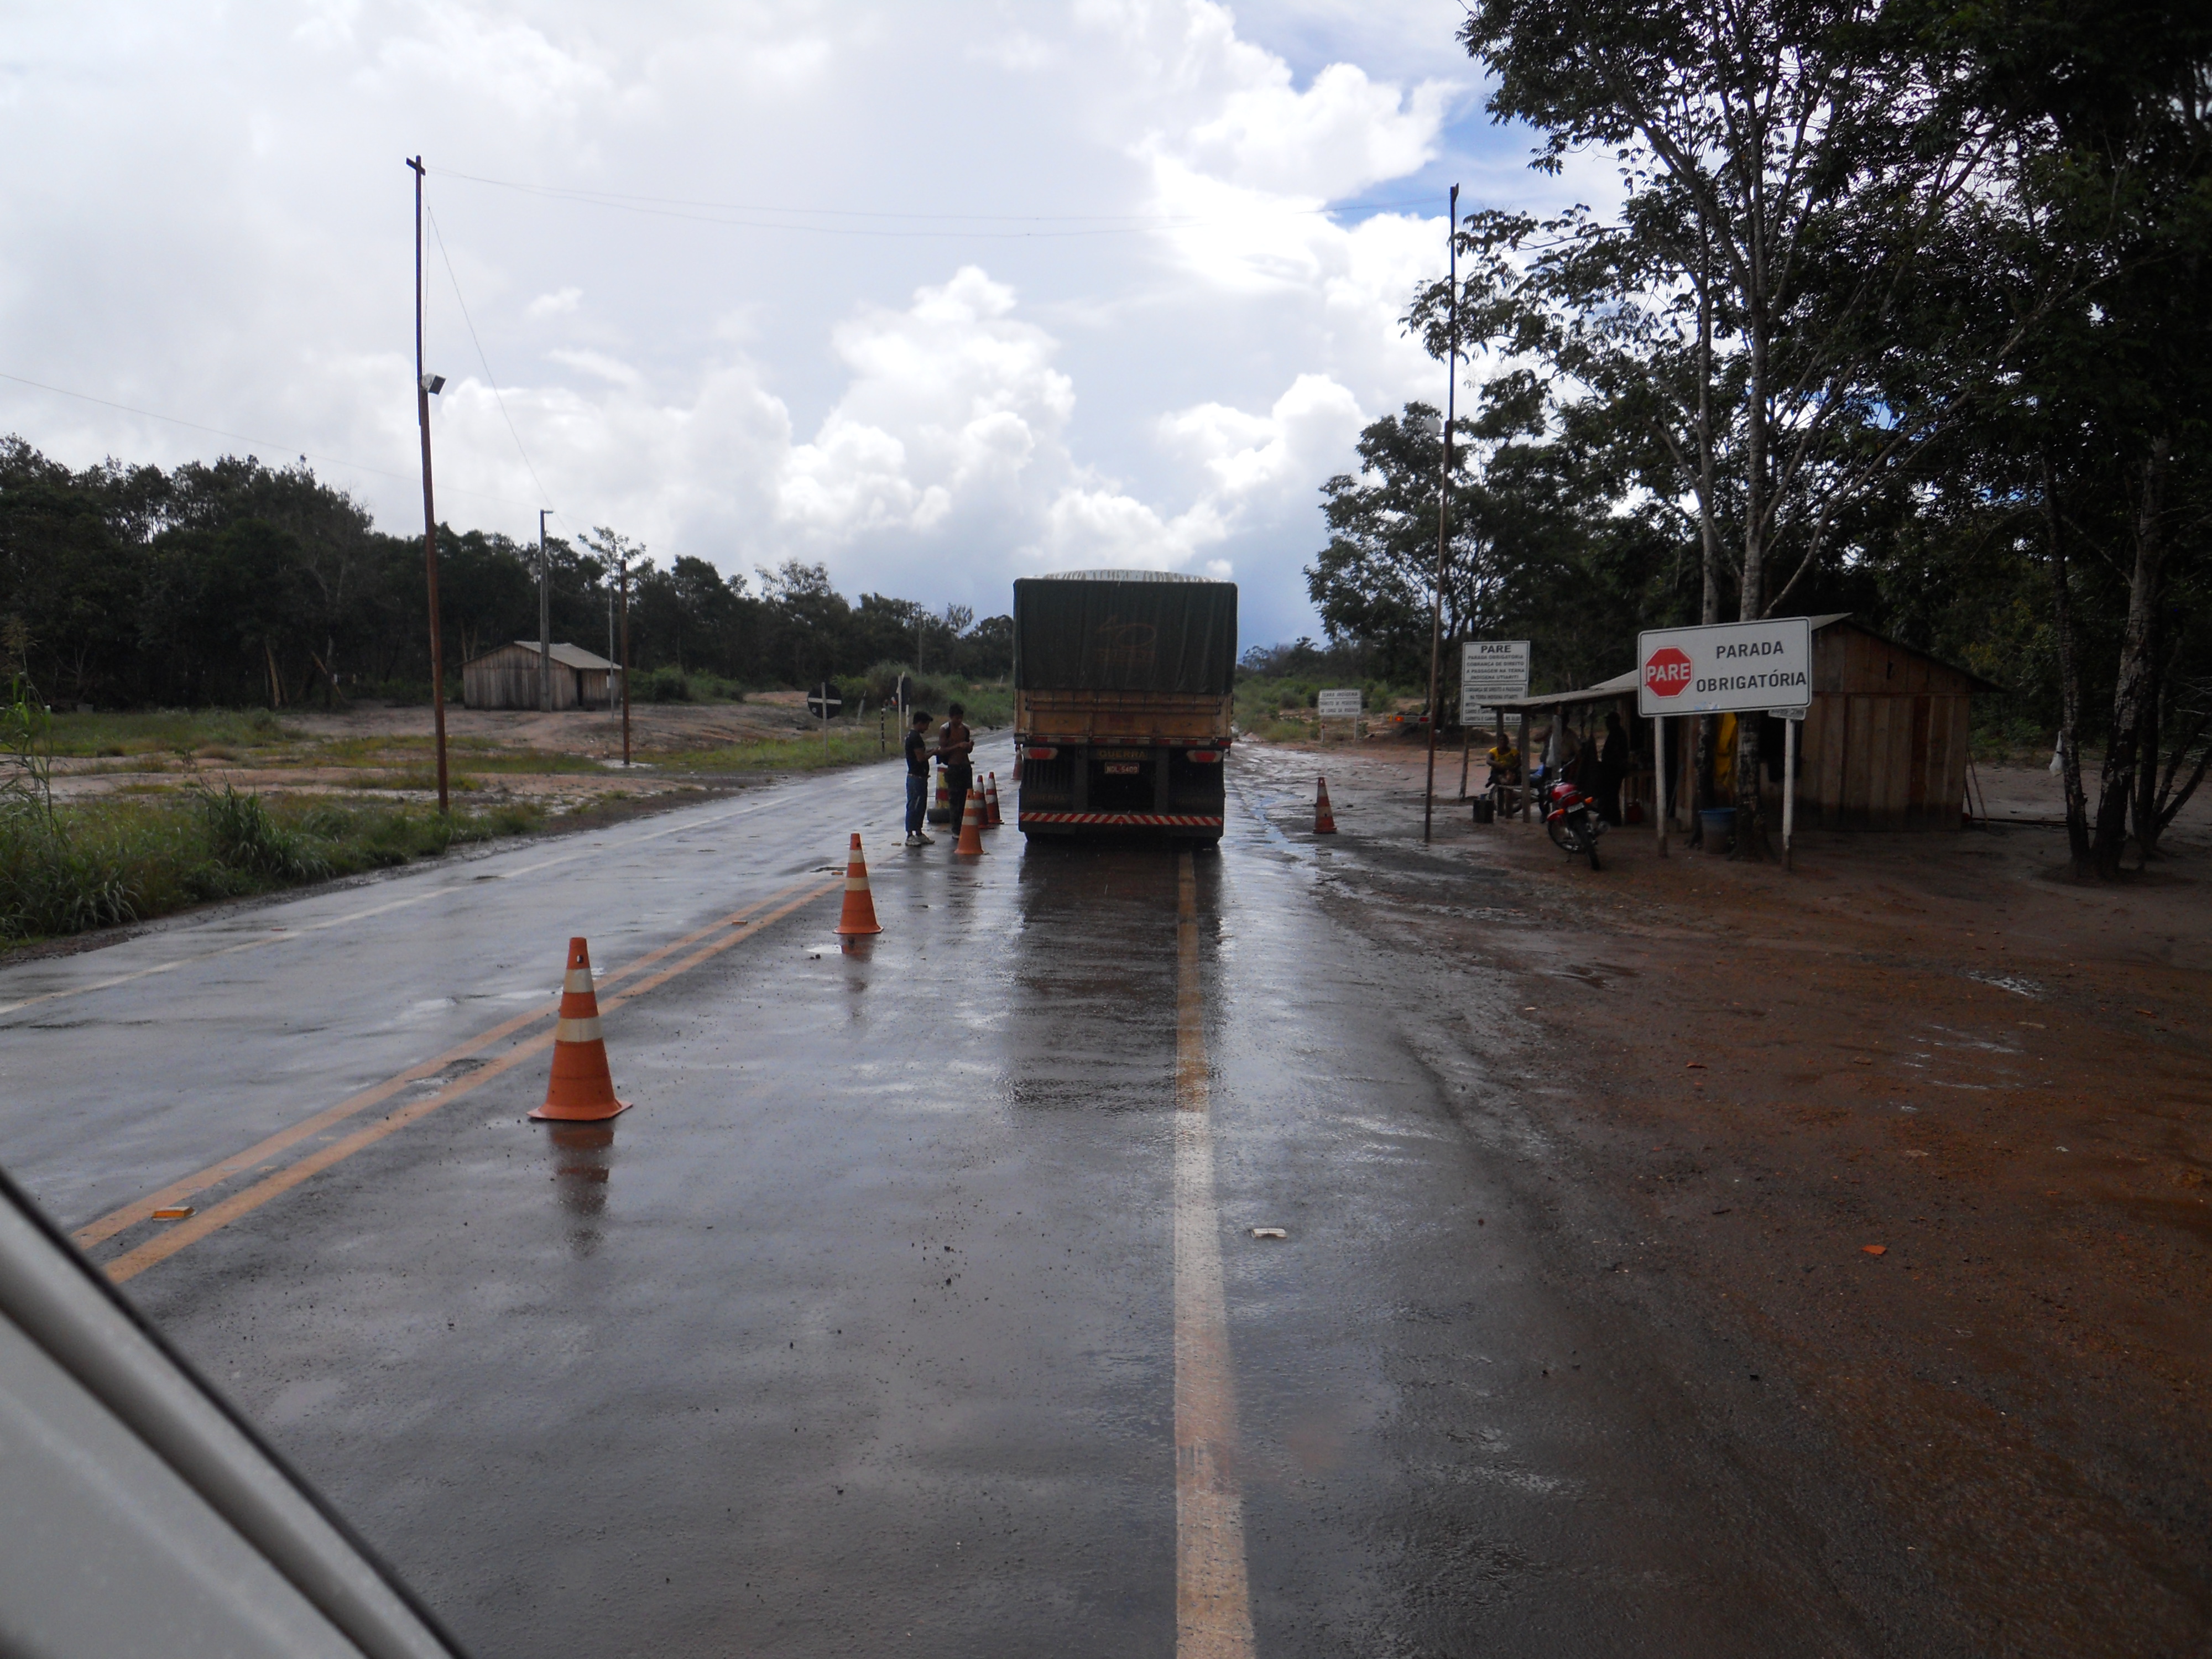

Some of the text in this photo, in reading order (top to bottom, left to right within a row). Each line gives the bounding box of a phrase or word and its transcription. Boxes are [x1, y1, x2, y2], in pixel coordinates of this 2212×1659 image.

[1481, 645, 1511, 653] PARE
[1716, 641, 1783, 659] PARADA
[1647, 663, 1691, 682] PARE
[1696, 670, 1807, 692] OBRIGATÓRIA
